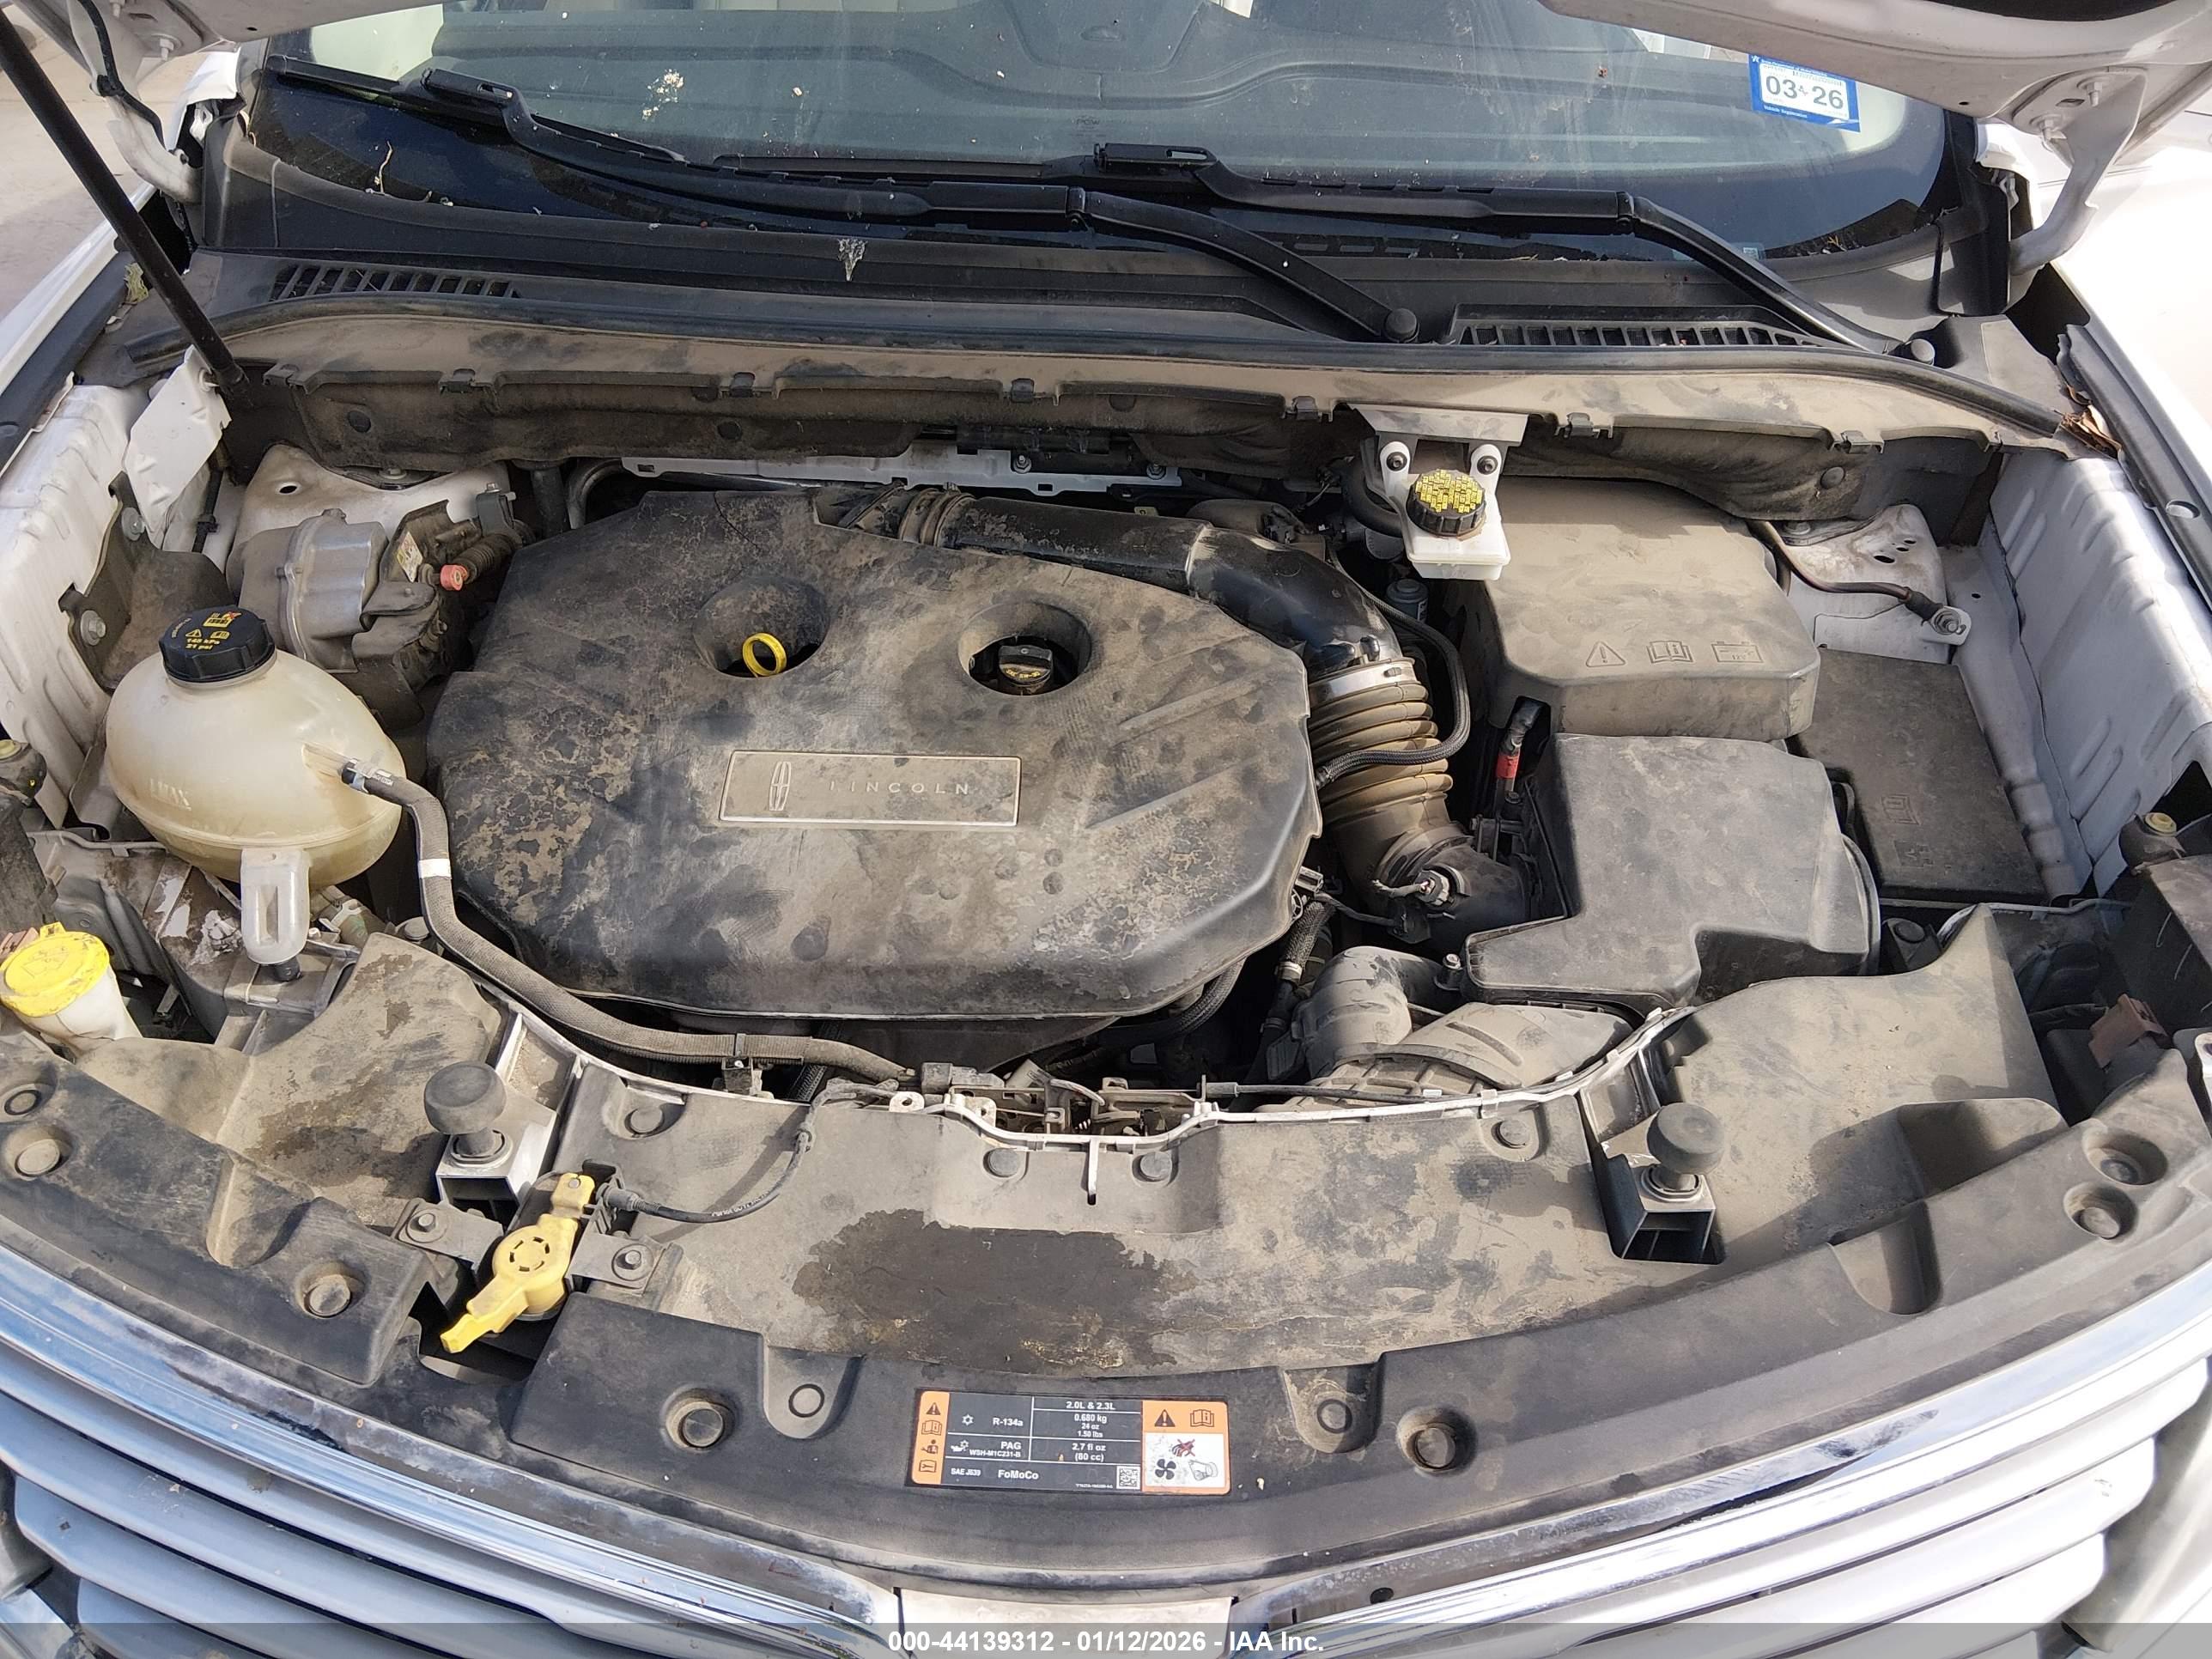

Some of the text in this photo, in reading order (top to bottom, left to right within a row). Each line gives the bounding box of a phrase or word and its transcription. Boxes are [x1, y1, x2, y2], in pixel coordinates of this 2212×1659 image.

[1765, 76, 1798, 99] 03
[1812, 86, 1844, 109] 26
[830, 781, 969, 795] LINCOLN
[1087, 1401, 1095, 1410] &
[1096, 1402, 1116, 1411] 2.3L
[992, 1417, 1024, 1427] R-134a
[1074, 1413, 1108, 1424] 0.680 kg
[1000, 1441, 1022, 1450] PAG
[1072, 1443, 1086, 1451] 2.7
[1074, 1453, 1104, 1462] (80 cc)
[998, 1469, 1039, 1480] FoMoCo
